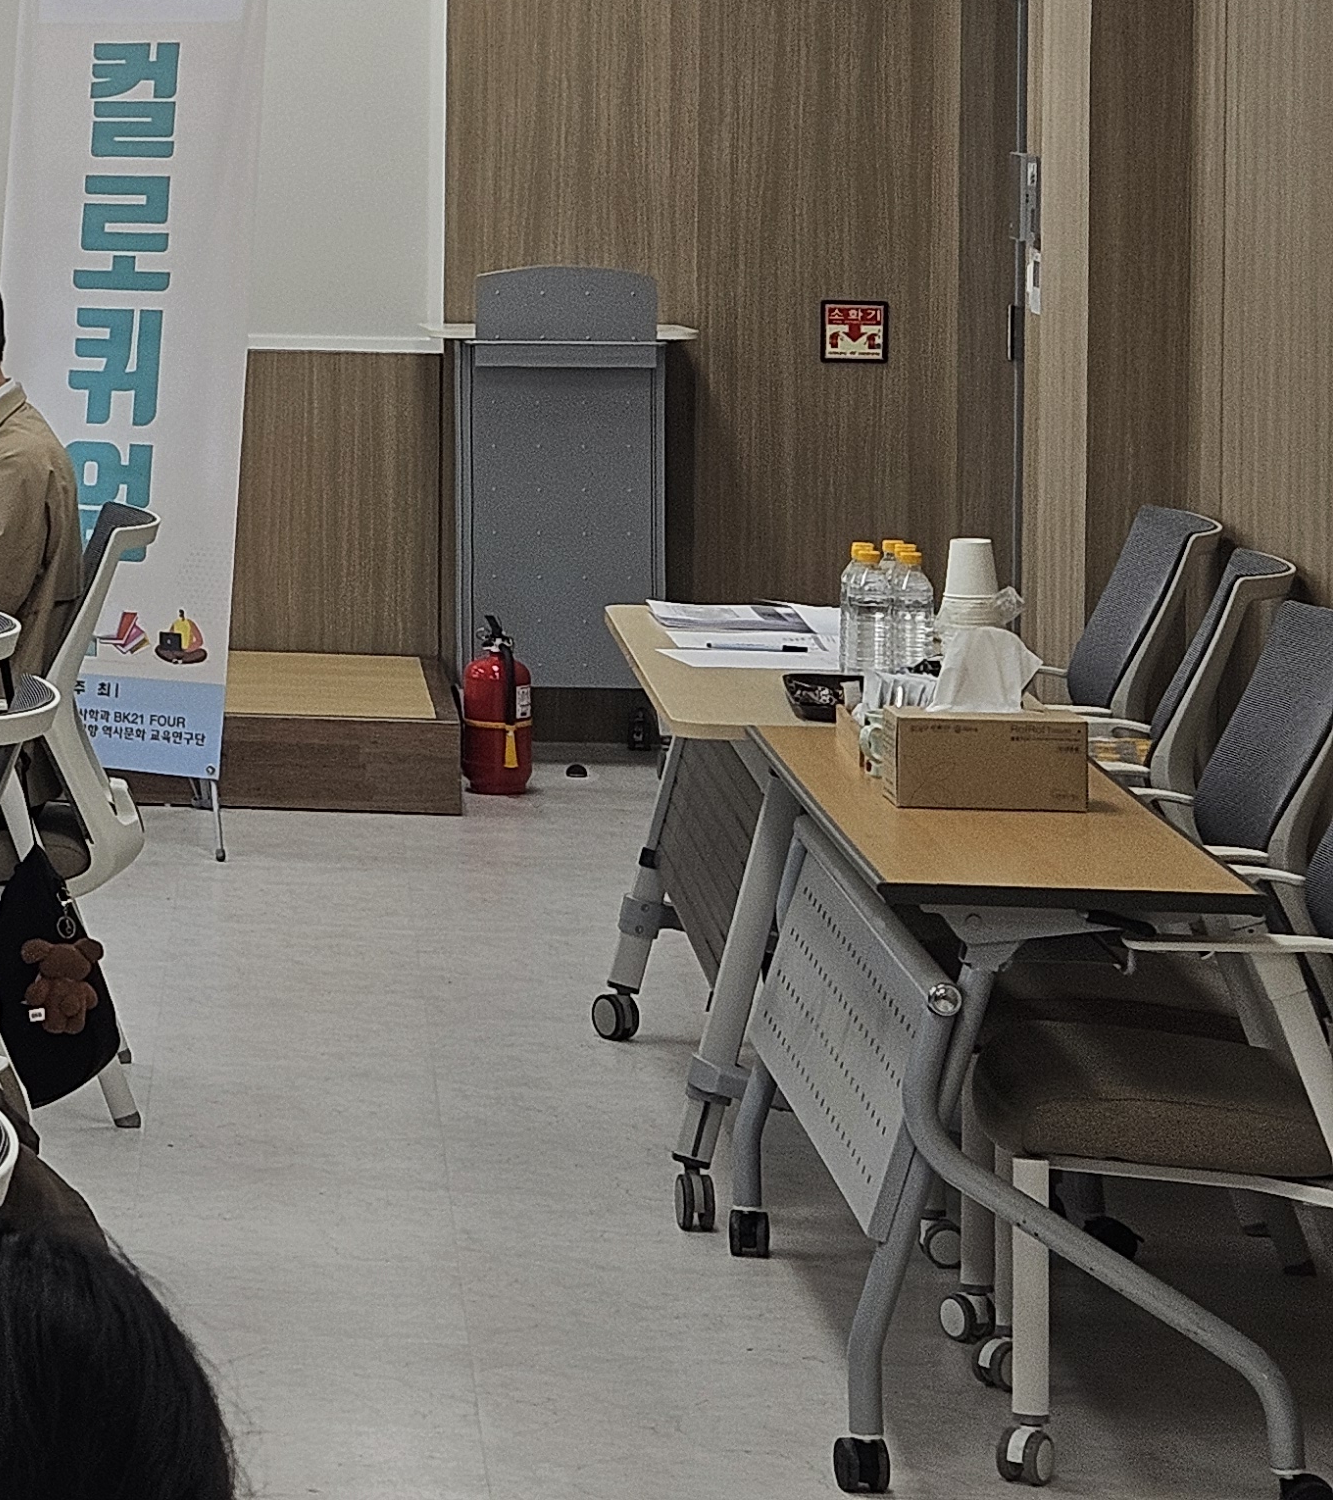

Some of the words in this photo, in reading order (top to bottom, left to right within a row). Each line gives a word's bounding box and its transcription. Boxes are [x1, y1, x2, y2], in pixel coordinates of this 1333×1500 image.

[829, 308, 881, 321] 소화기
[113, 712, 144, 725] BK21
[149, 715, 186, 728] FOUR
[102, 725, 147, 741] 역사문화
[150, 729, 206, 747] 교육연구단
